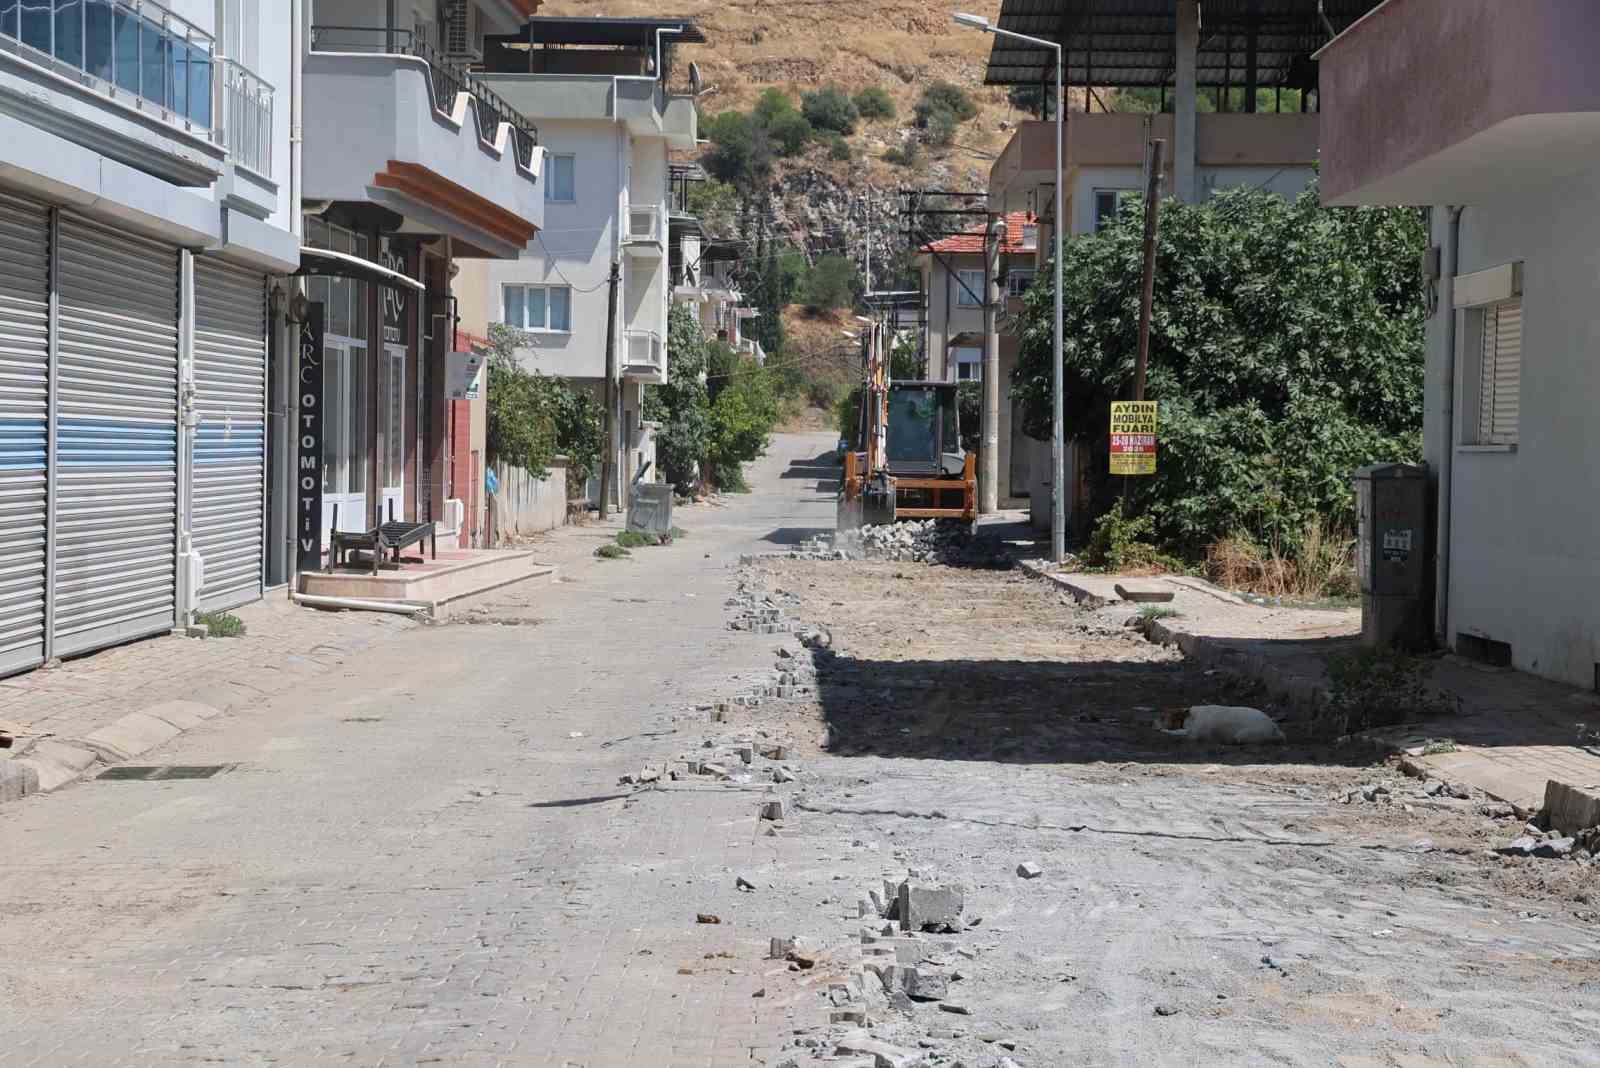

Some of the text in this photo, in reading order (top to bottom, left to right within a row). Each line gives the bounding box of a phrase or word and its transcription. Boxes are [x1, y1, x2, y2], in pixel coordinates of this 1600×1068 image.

[300, 322, 321, 384] ARC
[1114, 404, 1155, 414] AYDIN
[1113, 424, 1154, 433] FUARI
